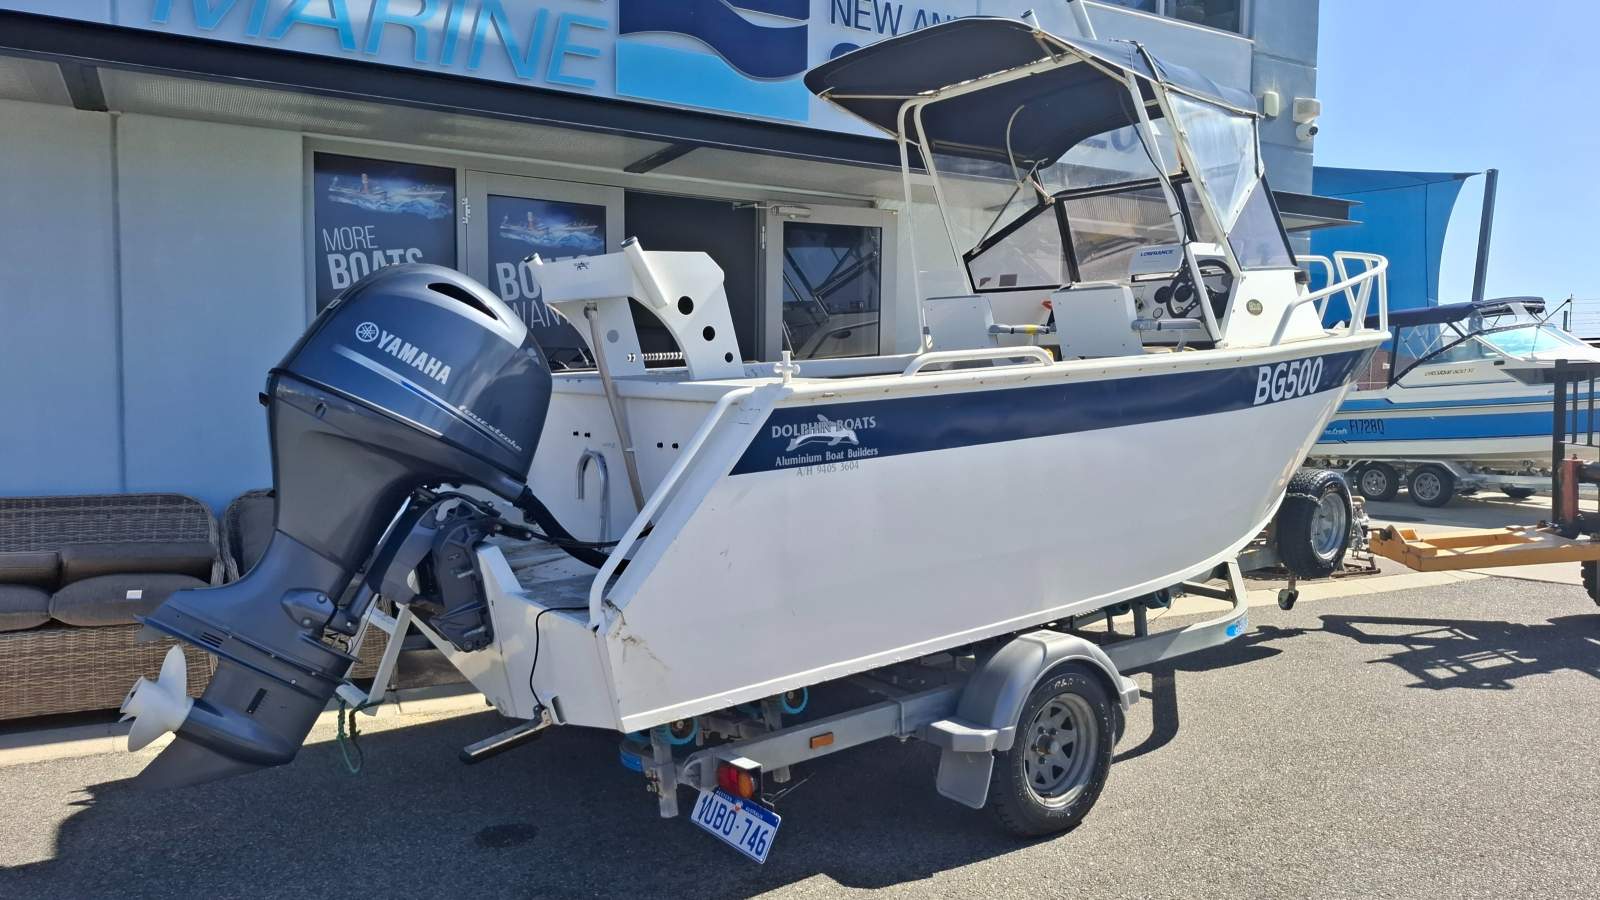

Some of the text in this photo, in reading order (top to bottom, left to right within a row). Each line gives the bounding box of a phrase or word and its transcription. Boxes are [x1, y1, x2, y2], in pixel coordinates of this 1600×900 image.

[830, 0, 903, 36] NEW
[322, 225, 379, 252] MORE
[377, 330, 451, 385] YAMAHA
[1253, 356, 1324, 406] BG500
[771, 415, 877, 438] DOLPHIN BOATS
[775, 446, 879, 467] Aluminium Boat Builders
